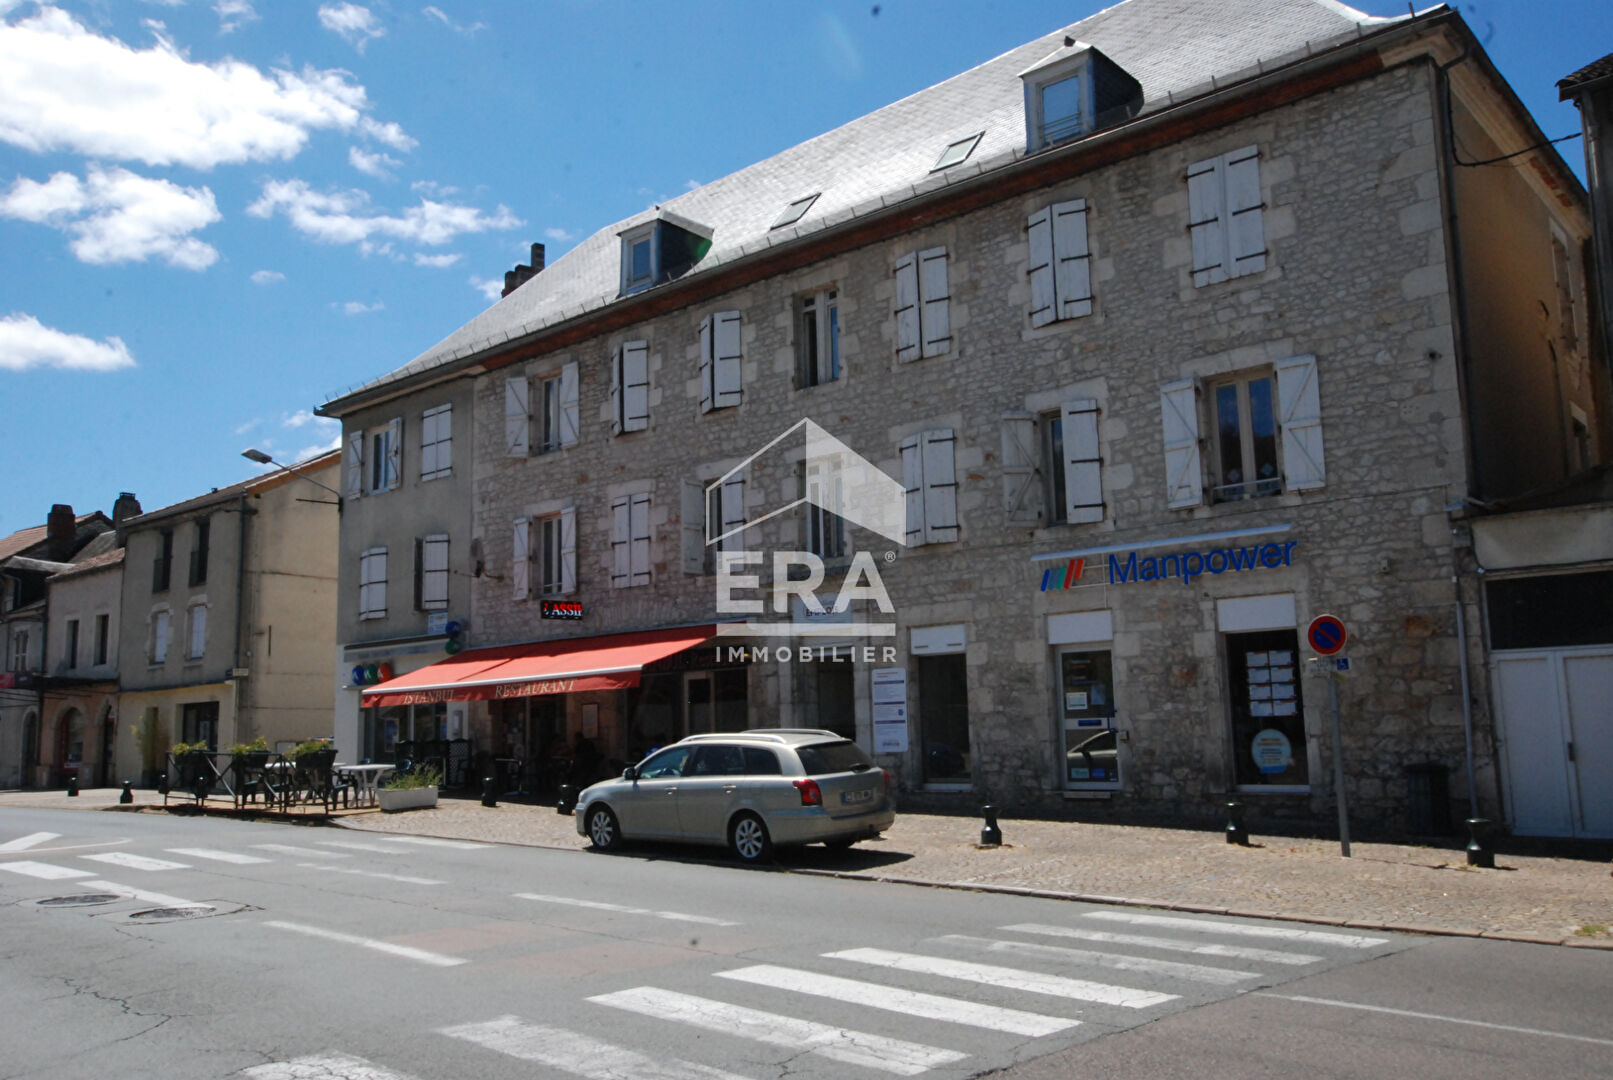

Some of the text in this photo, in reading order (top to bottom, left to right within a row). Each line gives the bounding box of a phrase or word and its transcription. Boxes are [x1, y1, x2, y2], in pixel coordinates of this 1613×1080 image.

[1108, 540, 1299, 584] Manpower
[403, 679, 576, 705] ISTANBUL RESTAURANT
